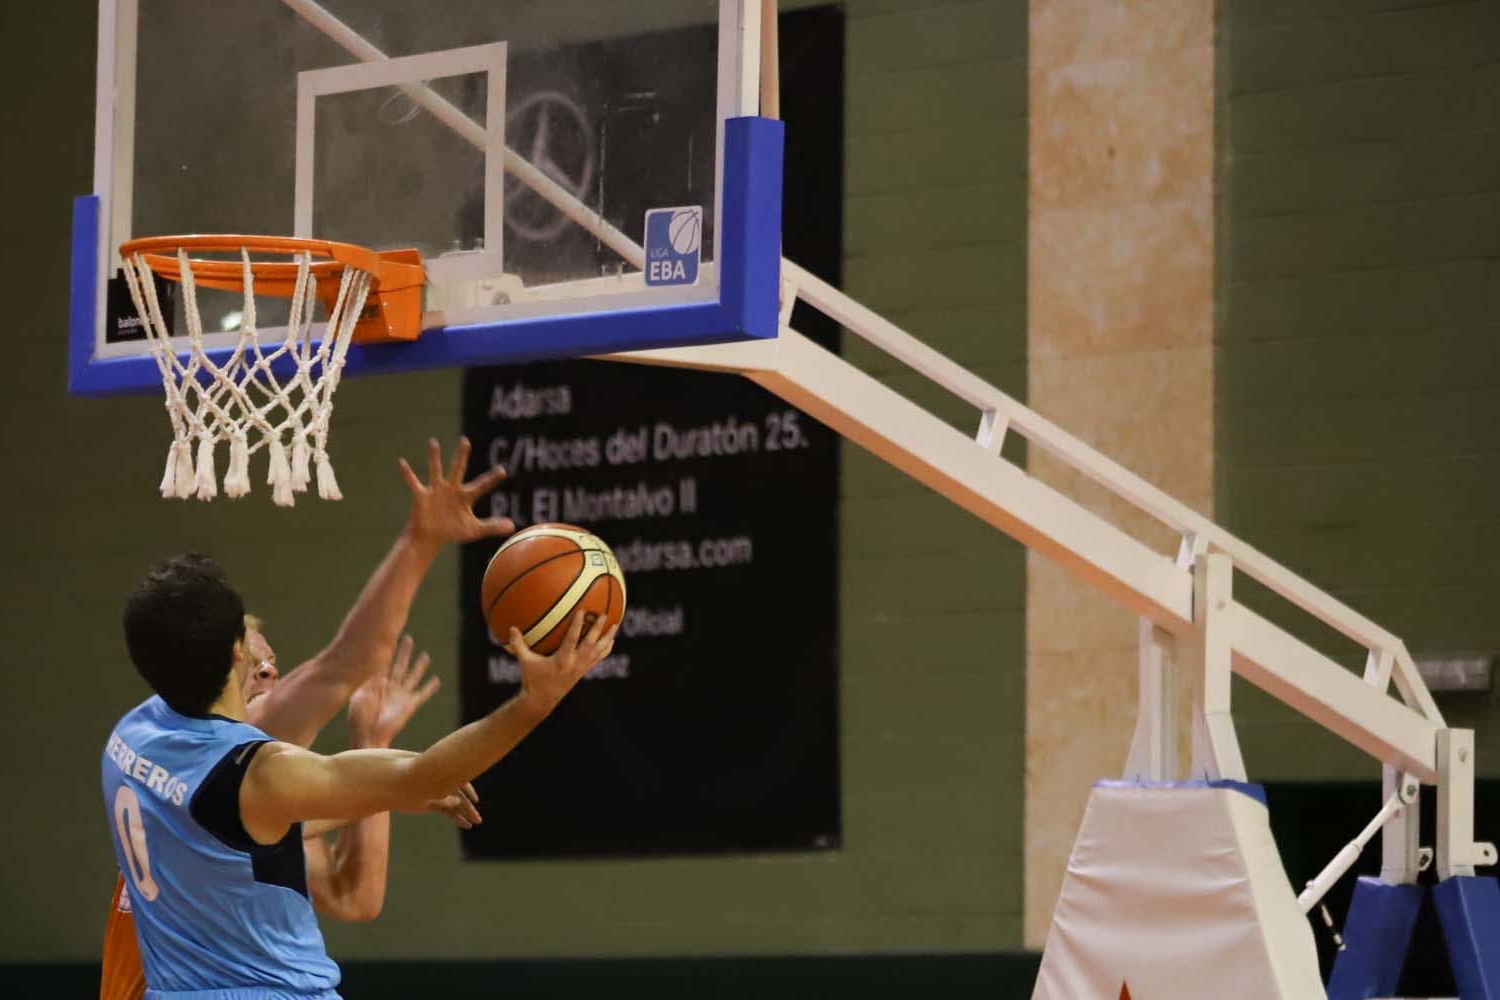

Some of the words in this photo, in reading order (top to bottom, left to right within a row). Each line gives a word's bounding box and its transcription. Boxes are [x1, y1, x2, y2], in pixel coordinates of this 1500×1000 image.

[650, 260, 686, 281] EBA
[651, 248, 669, 258] LIGA
[490, 383, 572, 419] Adarsa
[605, 427, 648, 465] del
[653, 415, 759, 461] Duratón
[563, 481, 675, 523] Montalvo
[114, 785, 160, 902] 0
